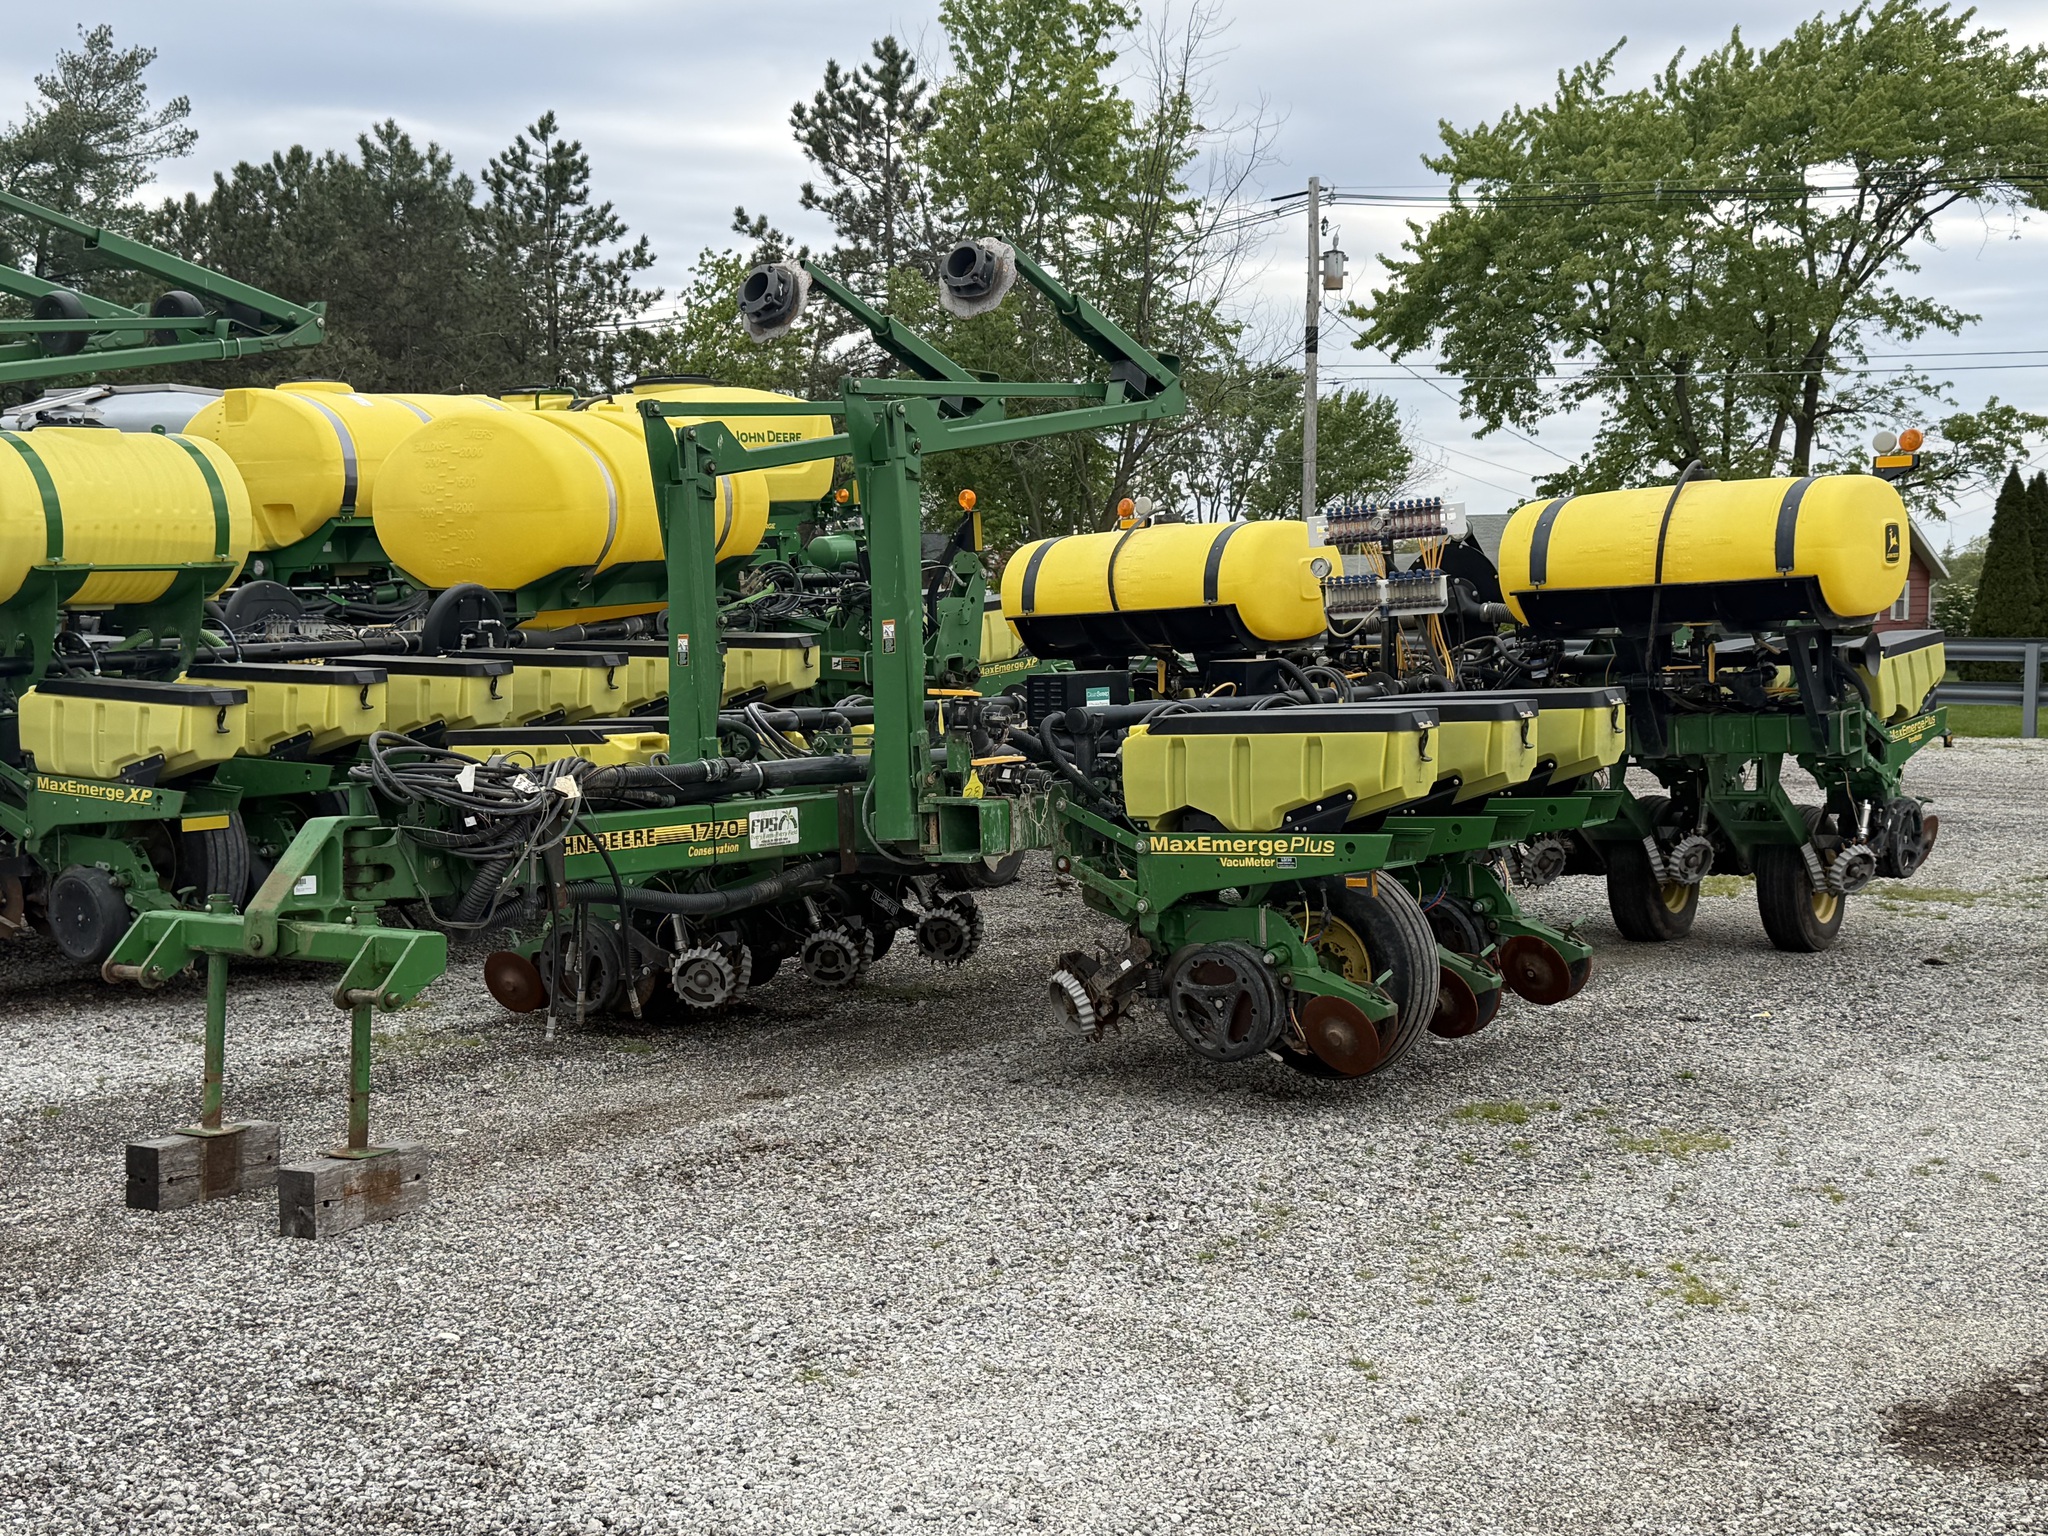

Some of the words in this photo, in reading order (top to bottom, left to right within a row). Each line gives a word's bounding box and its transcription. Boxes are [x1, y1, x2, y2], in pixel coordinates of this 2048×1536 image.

[736, 430, 766, 443] JOHN
[767, 430, 802, 442] DEERE
[459, 447, 483, 458] 2000
[454, 502, 474, 513] 1200
[1024, 657, 1038, 669] XP
[37, 776, 125, 801] MaxEmerge
[124, 787, 153, 803] XP
[691, 821, 739, 842] 1770
[688, 843, 740, 858] Conservation
[1220, 857, 1276, 868] VacuMeter
